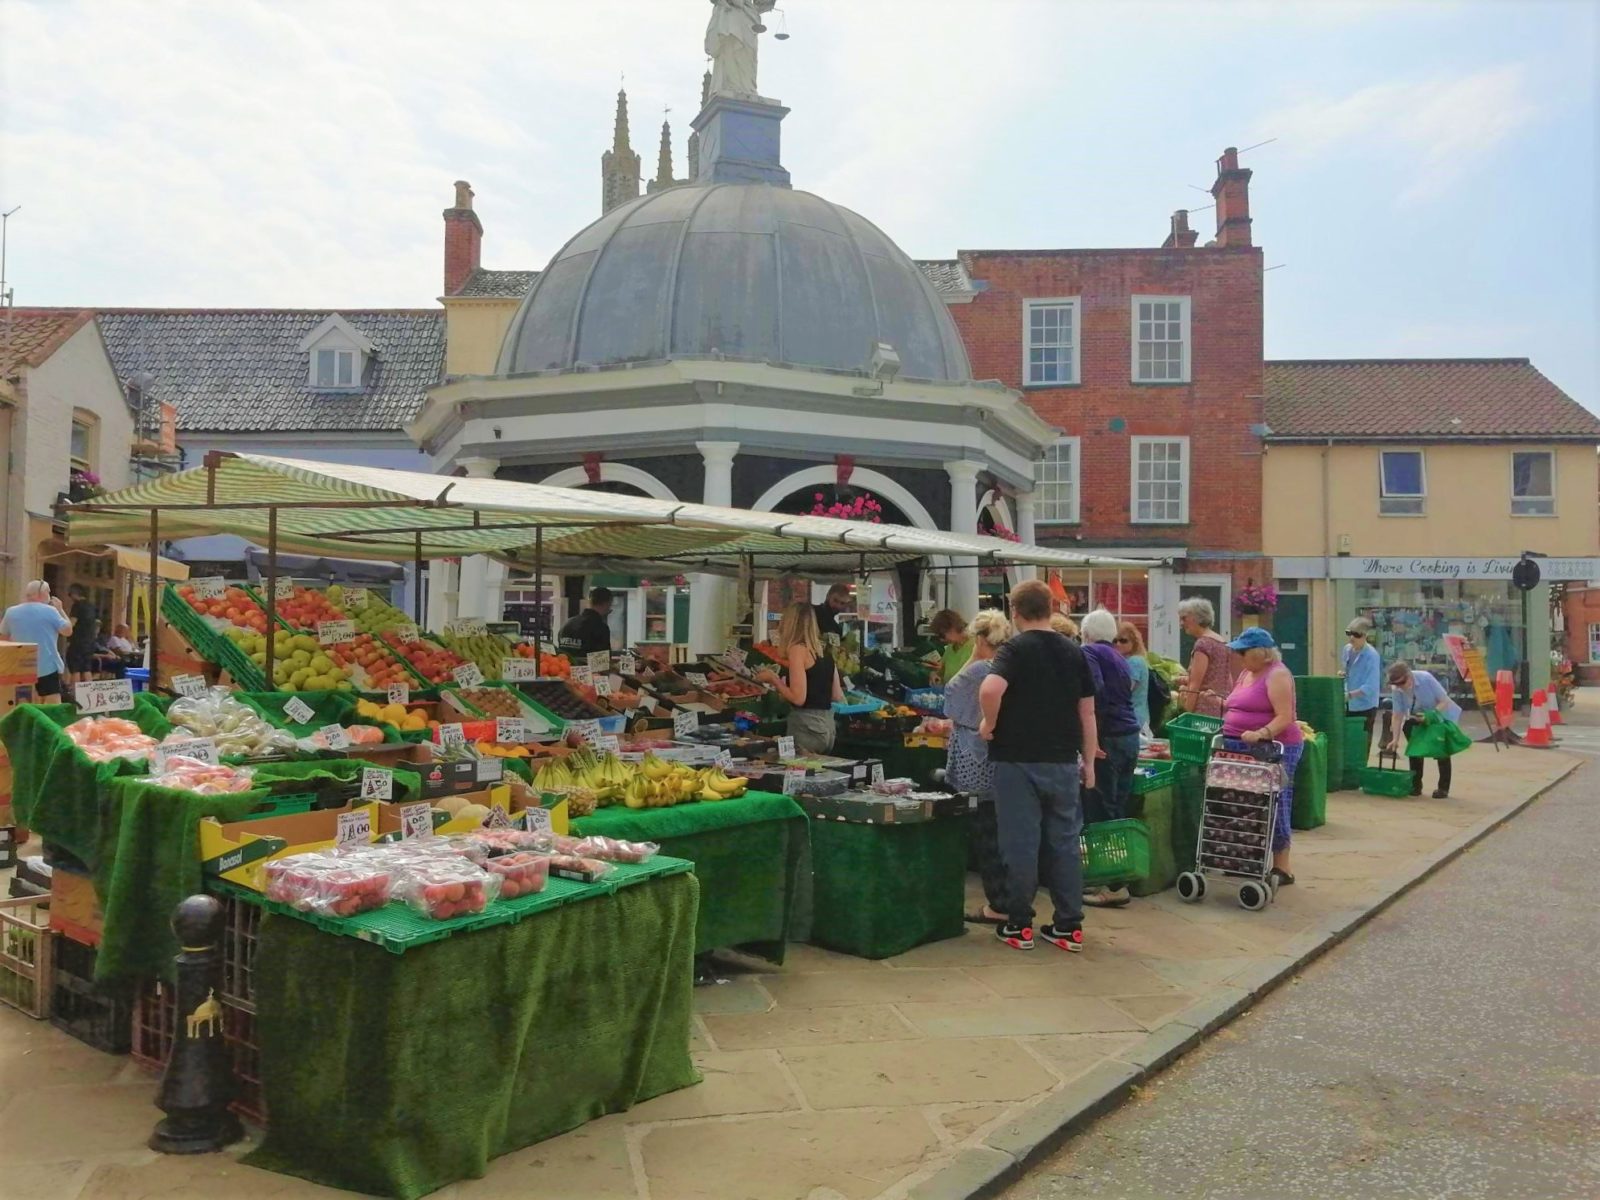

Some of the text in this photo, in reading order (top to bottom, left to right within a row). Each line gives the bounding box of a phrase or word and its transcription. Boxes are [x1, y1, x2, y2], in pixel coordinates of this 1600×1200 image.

[1363, 558, 1403, 574] Where
[1410, 559, 1460, 578] Cooking
[1466, 560, 1476, 574] is
